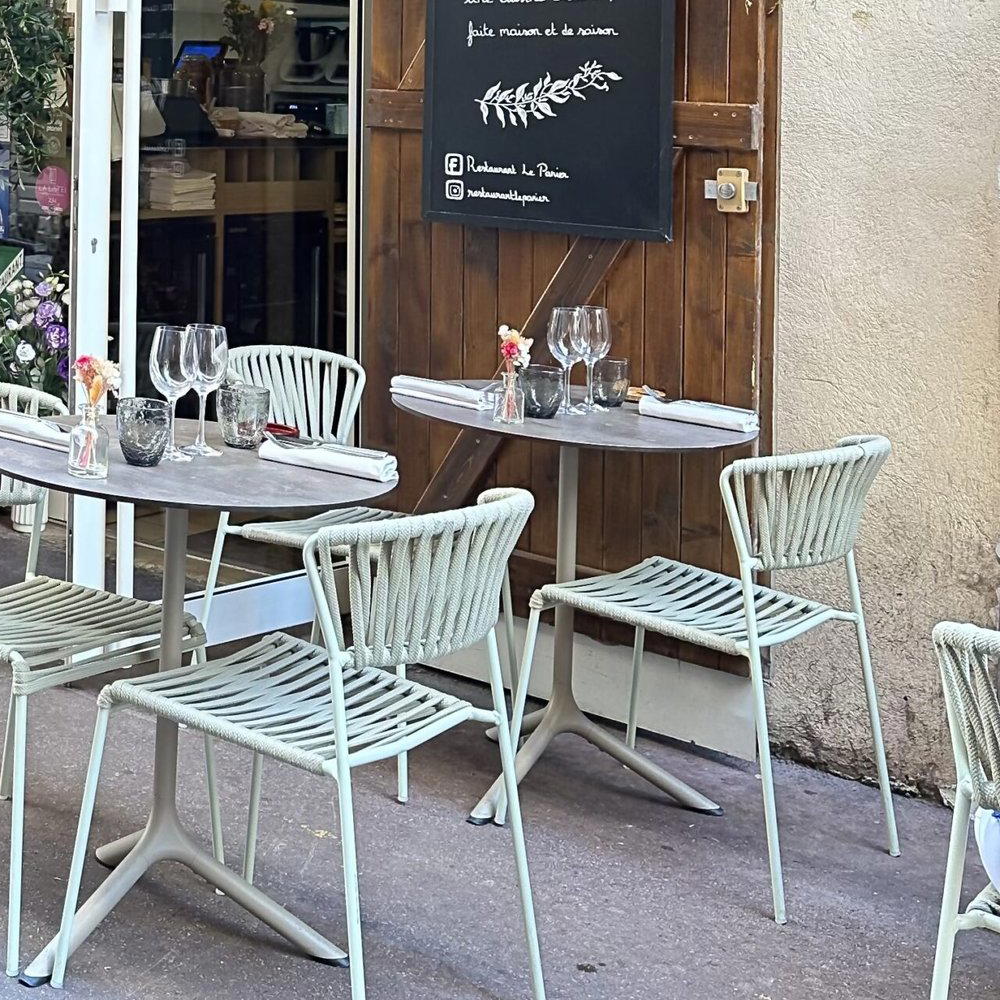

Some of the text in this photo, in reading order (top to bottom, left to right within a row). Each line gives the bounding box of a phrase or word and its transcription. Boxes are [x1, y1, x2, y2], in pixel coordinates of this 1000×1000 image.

[466, 20, 619, 47] faite maison et de saison
[466, 155, 570, 179] Restaurant Le Panier
